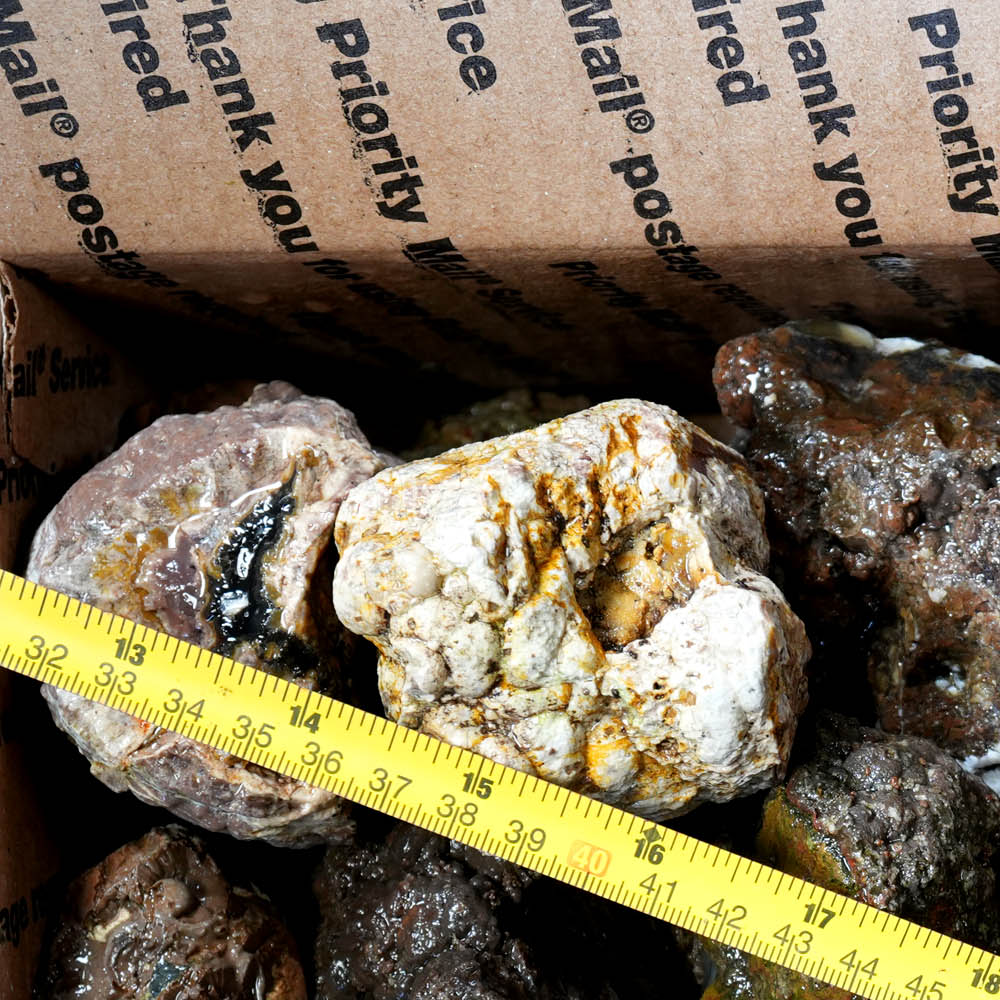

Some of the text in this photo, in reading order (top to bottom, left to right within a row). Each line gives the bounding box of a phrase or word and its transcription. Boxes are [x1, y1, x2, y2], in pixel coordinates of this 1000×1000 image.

[179, 0, 276, 152] hank
[239, 160, 319, 254] you
[316, 17, 428, 224] Priority
[812, 153, 883, 248] you
[908, 8, 999, 217] Priority
[24, 635, 69, 670] 32
[94, 662, 138, 696] 33
[163, 689, 206, 722] 34
[232, 715, 276, 748] 35
[300, 742, 344, 775] 36
[368, 768, 413, 799] 37
[436, 794, 479, 827] 38
[504, 820, 547, 853] 39
[639, 872, 678, 903] 41
[706, 898, 748, 931] 42
[773, 924, 815, 955] 43
[839, 949, 880, 980] 44
[115, 637, 147, 667] 13
[289, 705, 322, 734] 14
[462, 772, 494, 800] 15
[633, 838, 666, 866] 16
[803, 903, 836, 930] 17
